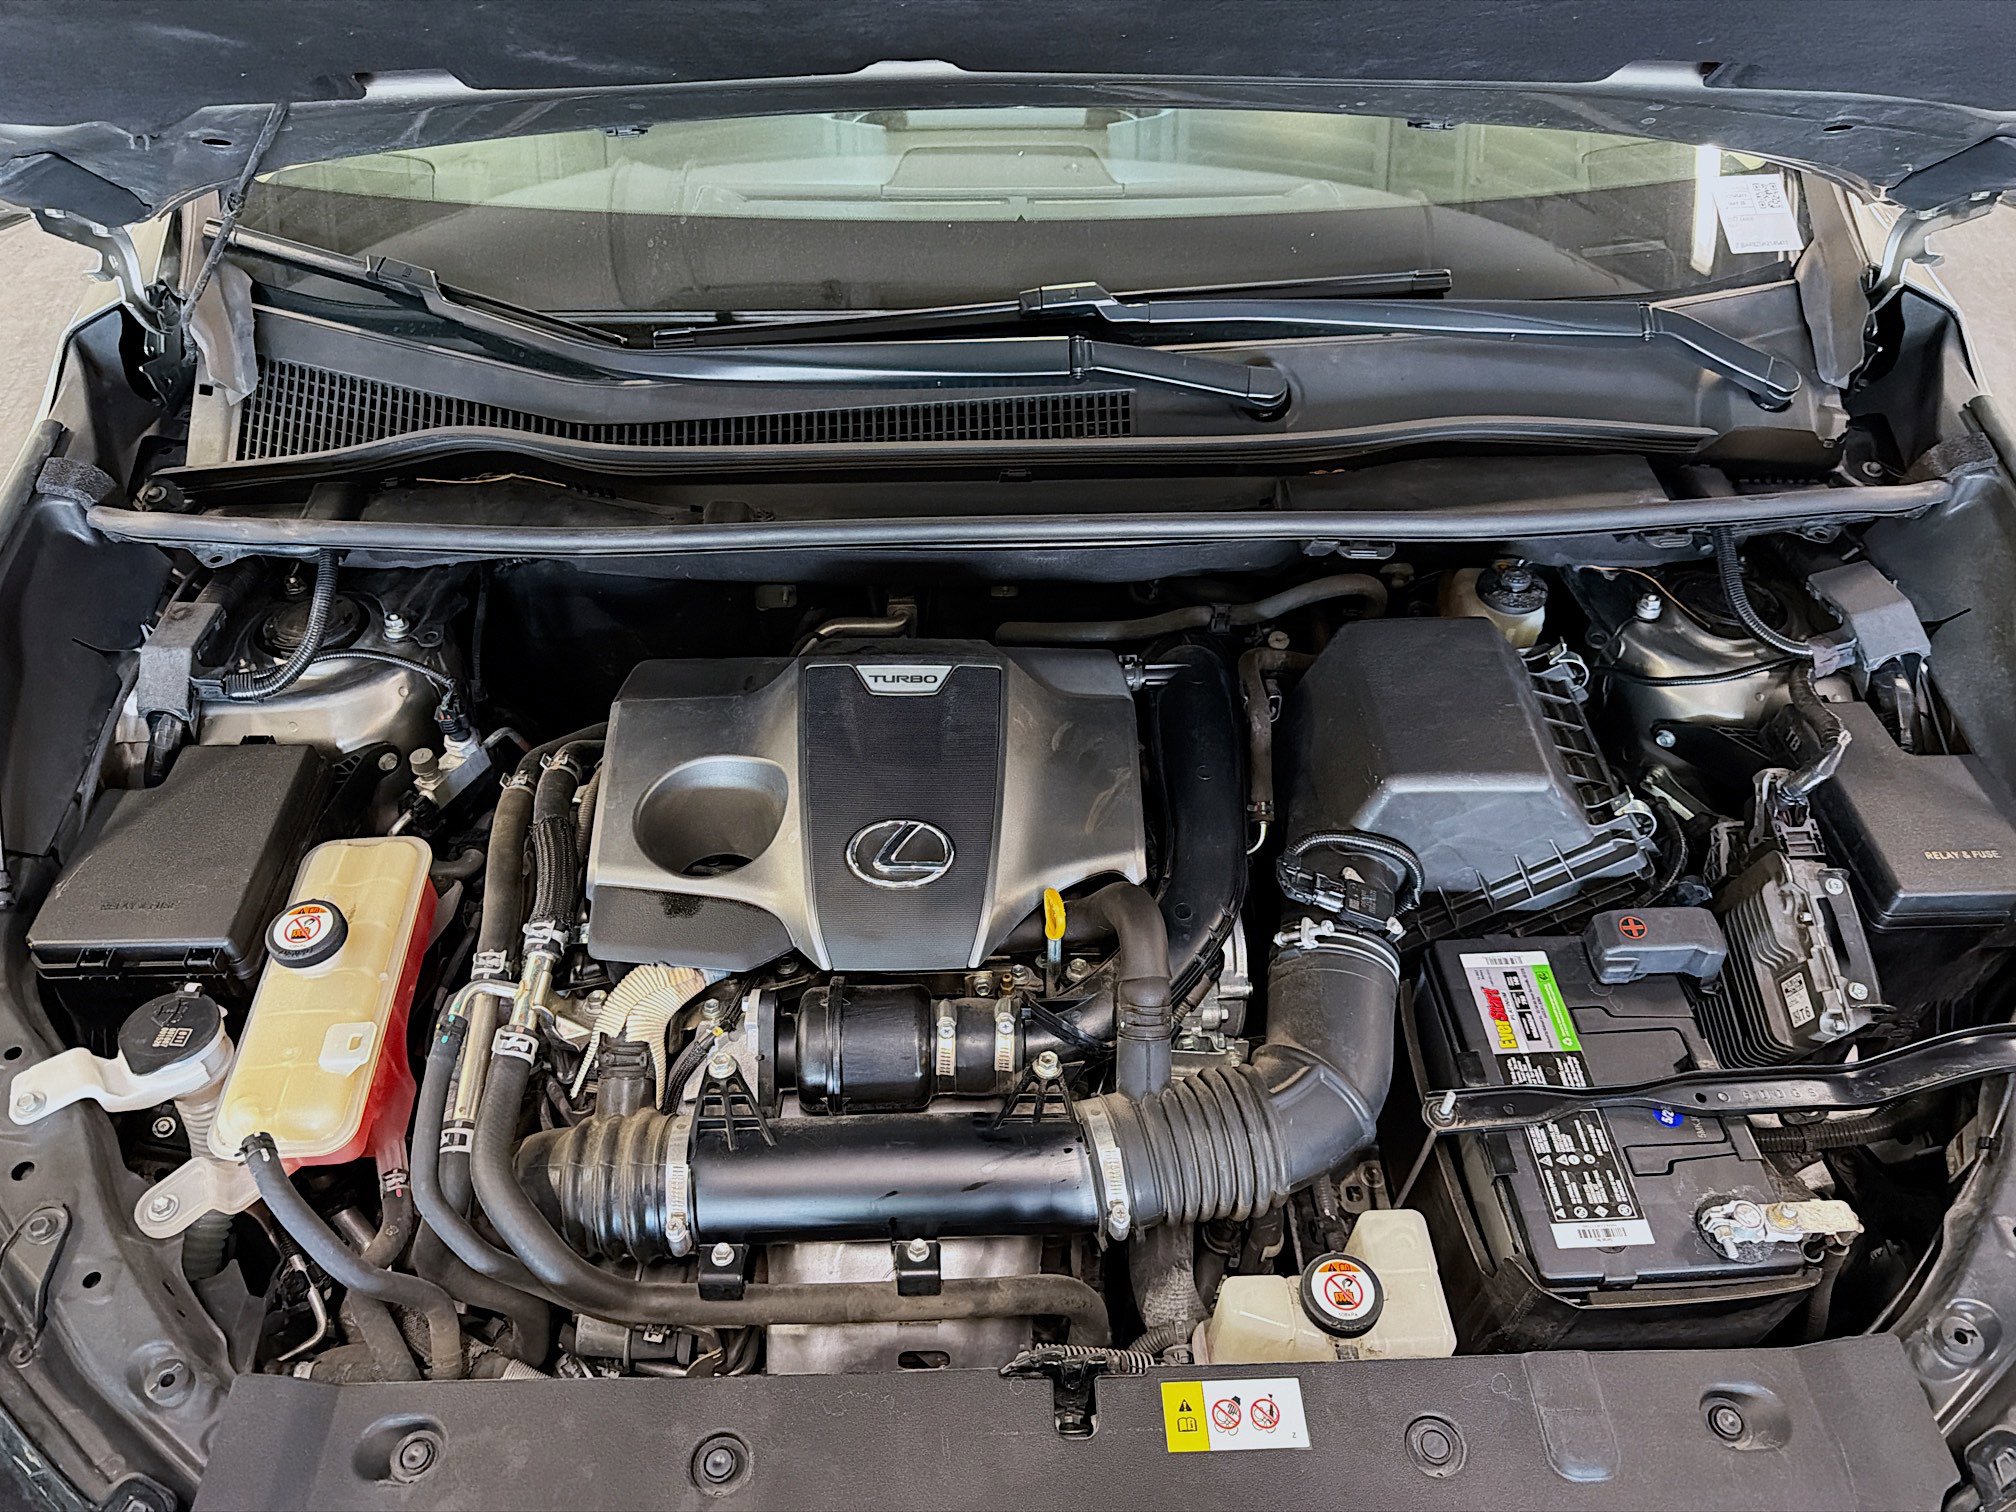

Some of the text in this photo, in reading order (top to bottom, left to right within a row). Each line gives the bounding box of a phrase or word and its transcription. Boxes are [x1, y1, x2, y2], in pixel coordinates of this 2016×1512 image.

[868, 674, 938, 684] TURBO
[1924, 848, 2002, 860] RELAY & FUSE
[1501, 992, 1516, 1021] PLATINUM
[1481, 986, 1519, 1050] EverStart
